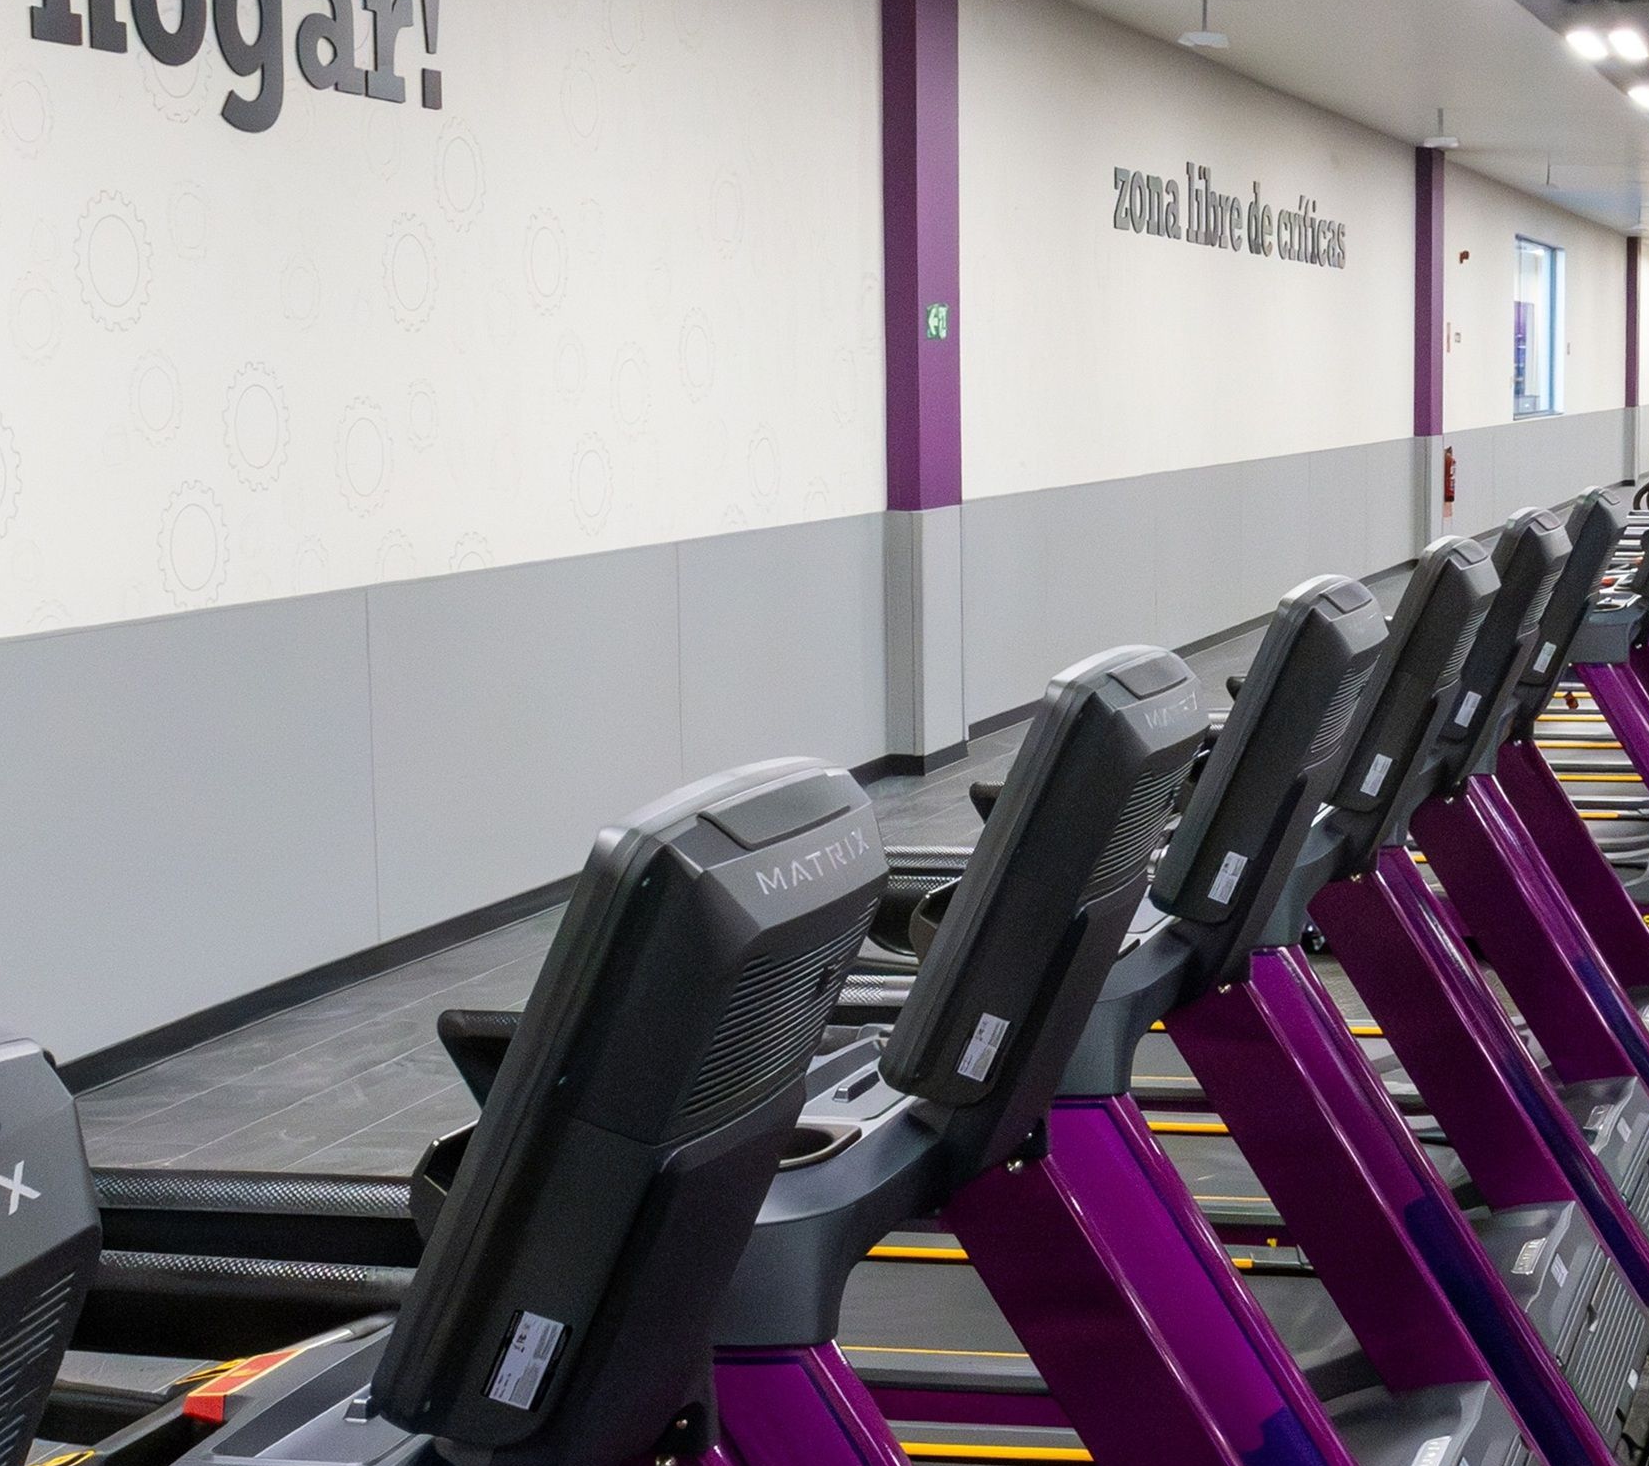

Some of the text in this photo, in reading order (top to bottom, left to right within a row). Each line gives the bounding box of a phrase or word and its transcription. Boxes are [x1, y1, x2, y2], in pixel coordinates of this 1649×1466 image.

[1113, 161, 1346, 270] zona libre de críticas
[756, 827, 872, 896] MATRIX
